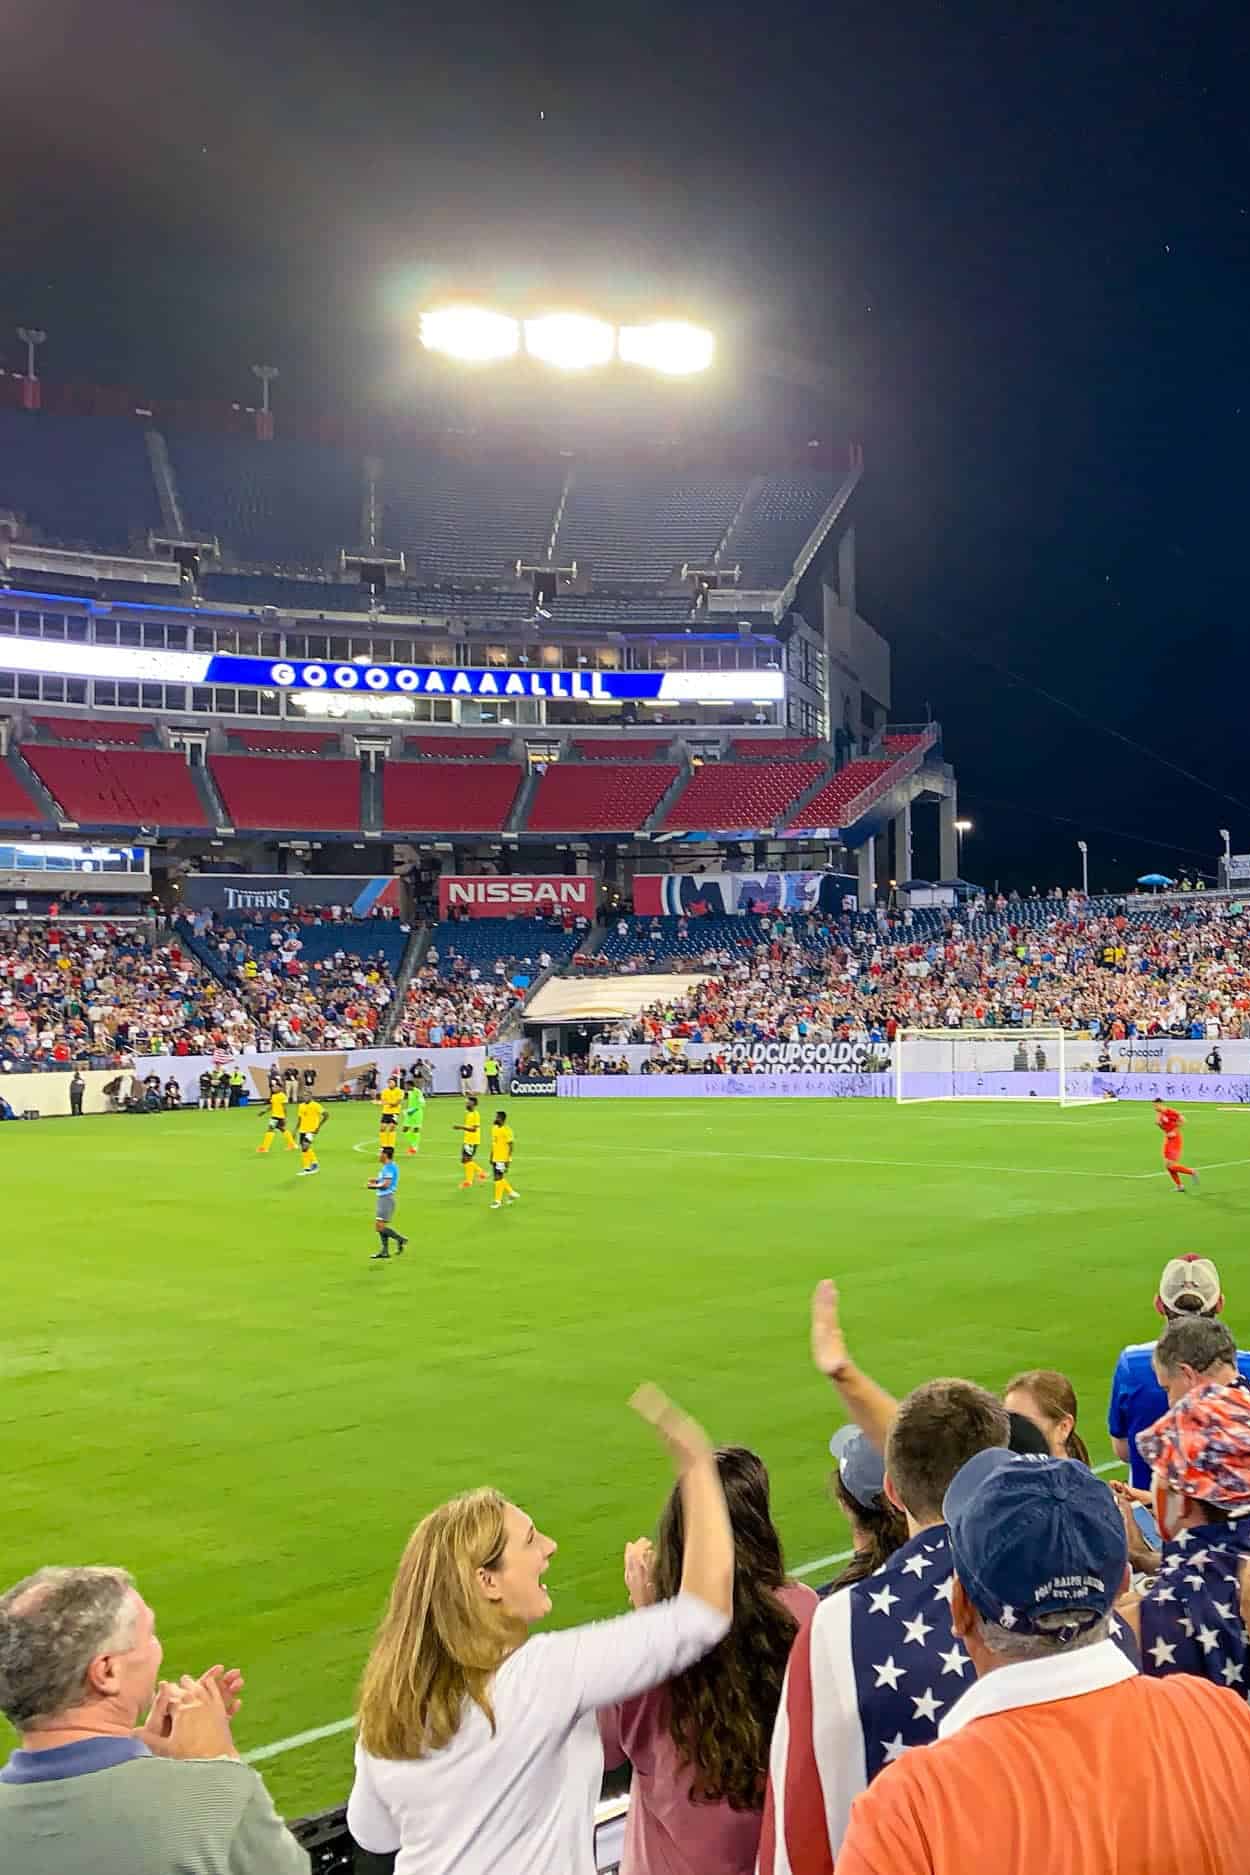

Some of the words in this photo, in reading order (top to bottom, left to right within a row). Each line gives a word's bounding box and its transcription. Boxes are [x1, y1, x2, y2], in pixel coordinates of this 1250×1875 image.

[270, 662, 613, 699] GOOOOAAAALLLL
[224, 887, 291, 911] TITANS
[448, 882, 587, 903] NISSAN
[511, 1079, 557, 1096] Concacaf
